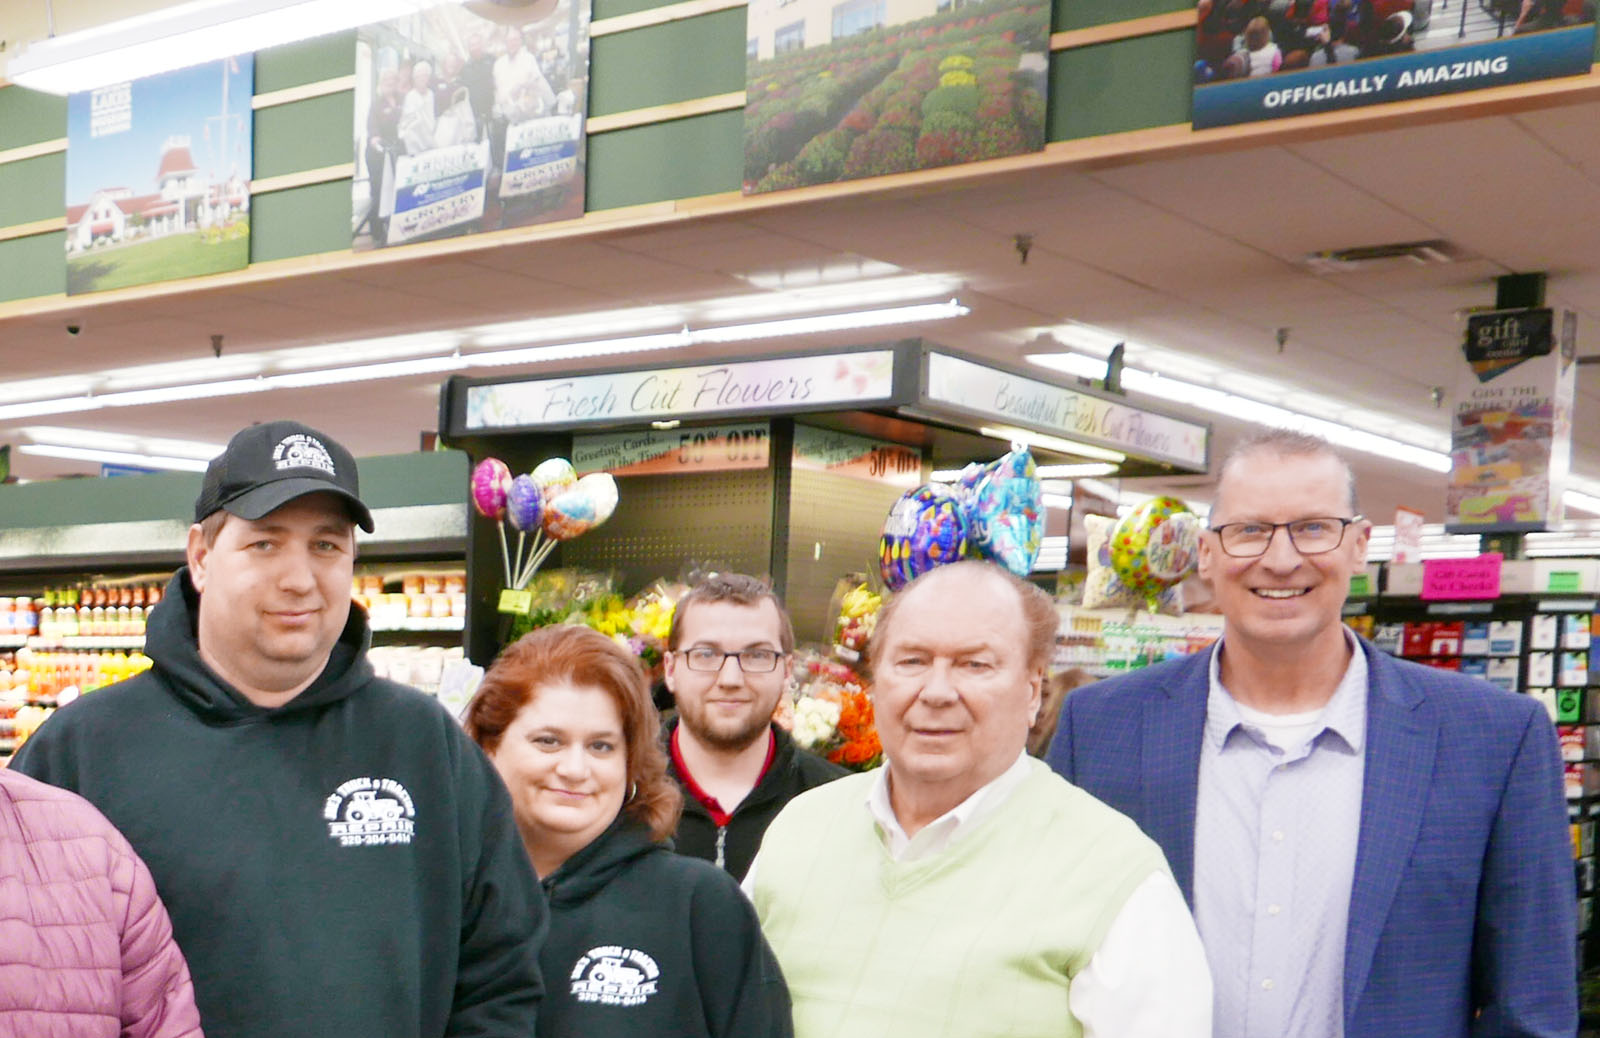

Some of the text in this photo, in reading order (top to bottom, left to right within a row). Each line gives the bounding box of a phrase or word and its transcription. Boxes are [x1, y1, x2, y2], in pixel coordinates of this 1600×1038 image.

[1263, 56, 1508, 108] OFFICIALLY AMAZING
[1477, 318, 1522, 347] gift
[542, 367, 815, 419] Fresh Cut Flowers
